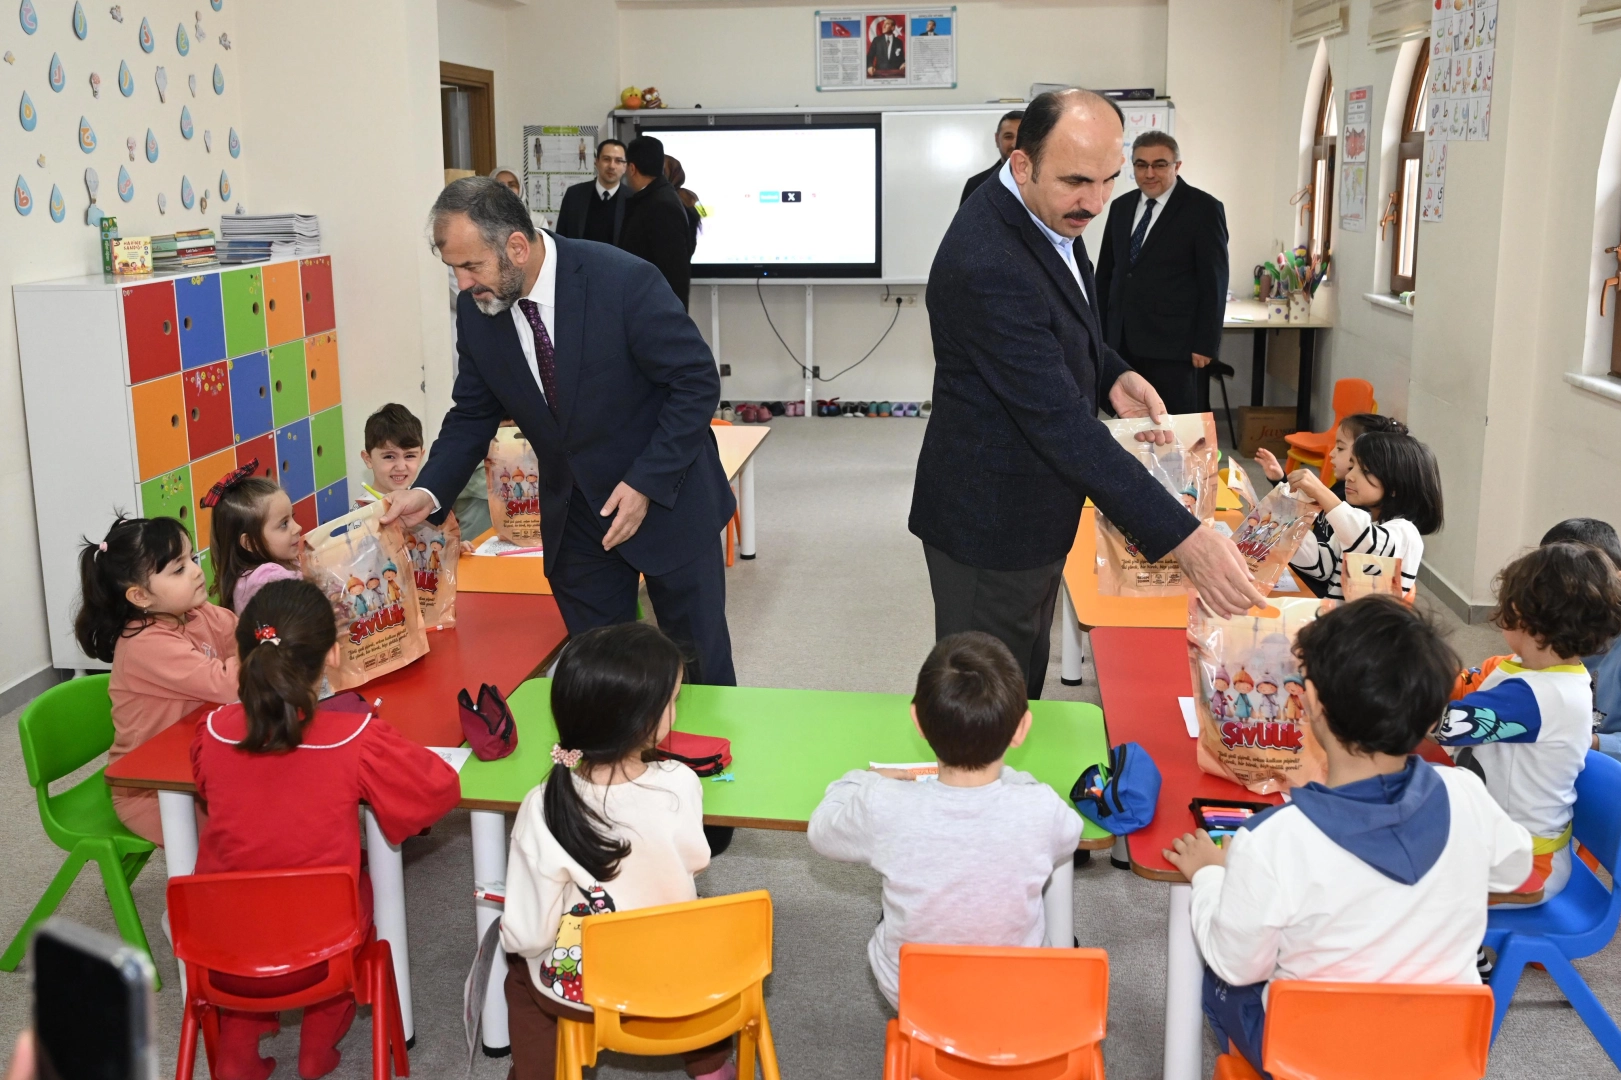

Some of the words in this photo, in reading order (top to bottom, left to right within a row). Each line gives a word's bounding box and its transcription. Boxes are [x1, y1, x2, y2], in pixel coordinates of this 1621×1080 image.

[506, 499, 540, 519] Şivlil
[349, 603, 405, 645] Şivlilik
[1220, 721, 1304, 754] Şivlilik
